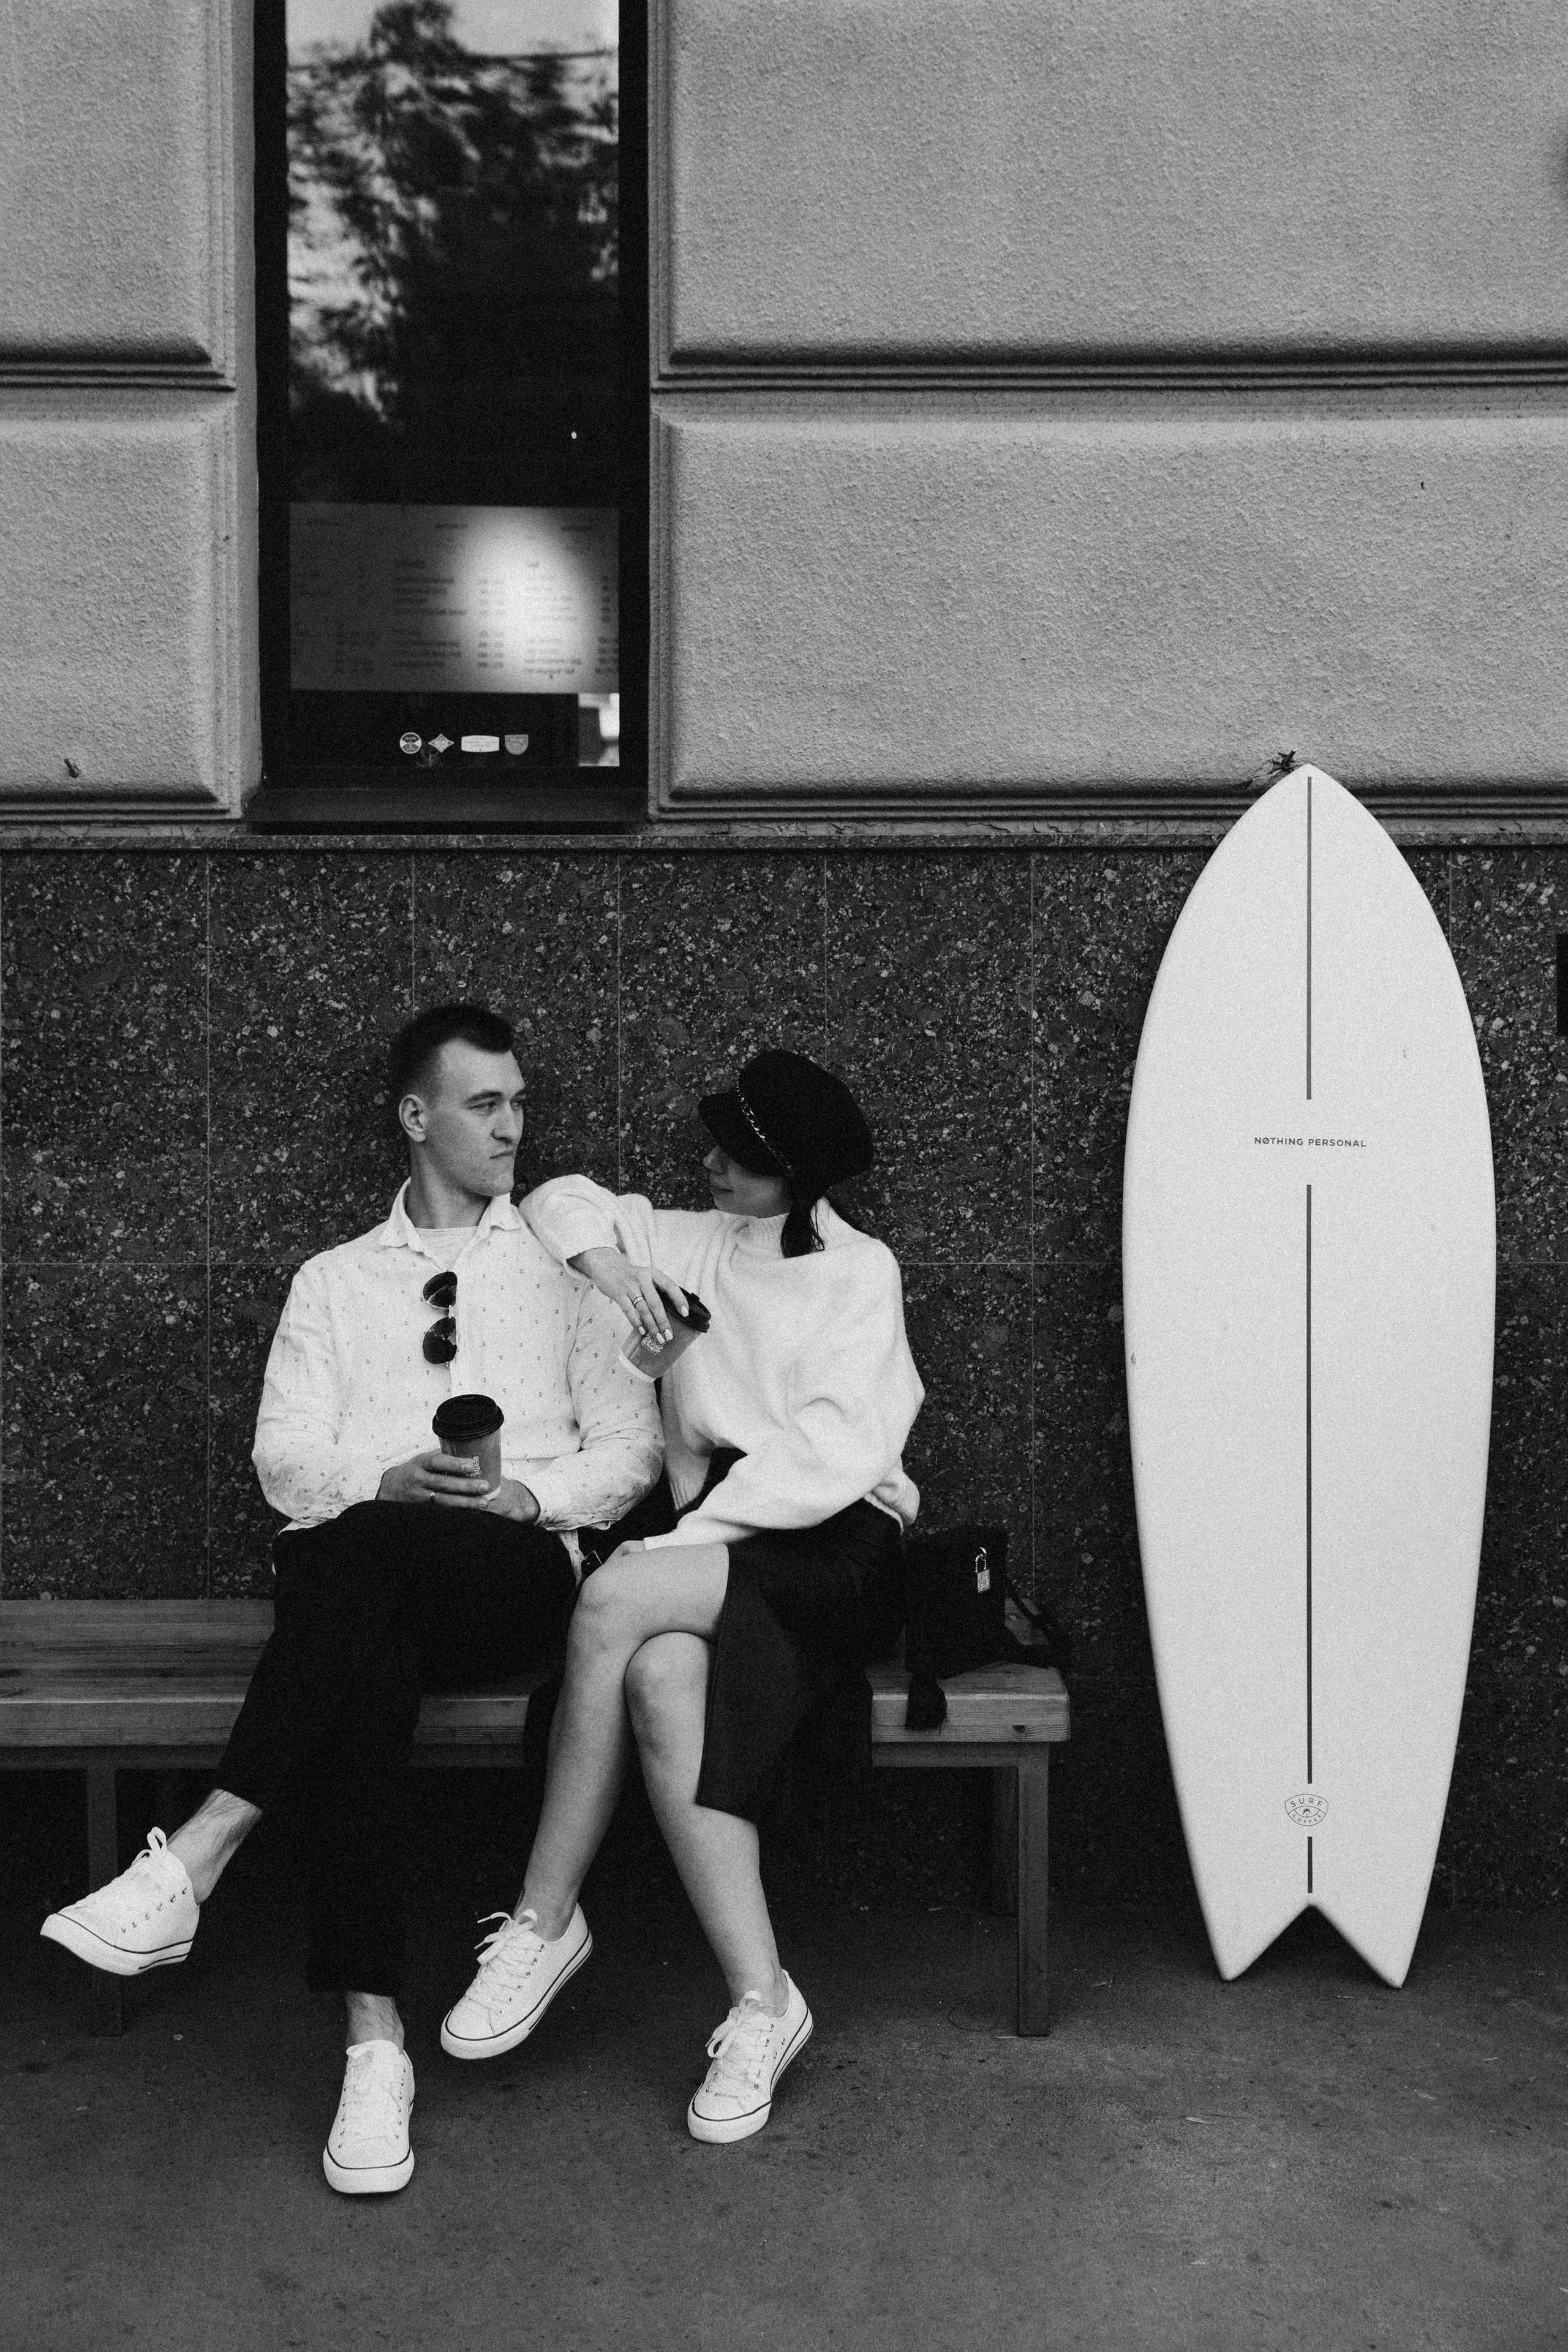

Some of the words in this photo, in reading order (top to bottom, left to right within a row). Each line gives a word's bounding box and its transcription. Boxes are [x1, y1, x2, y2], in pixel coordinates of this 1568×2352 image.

[1308, 1139, 1366, 1147] PERSONAL
[1291, 1798, 1323, 1807] SURF
[1292, 1814, 1322, 1823] COFFEE
